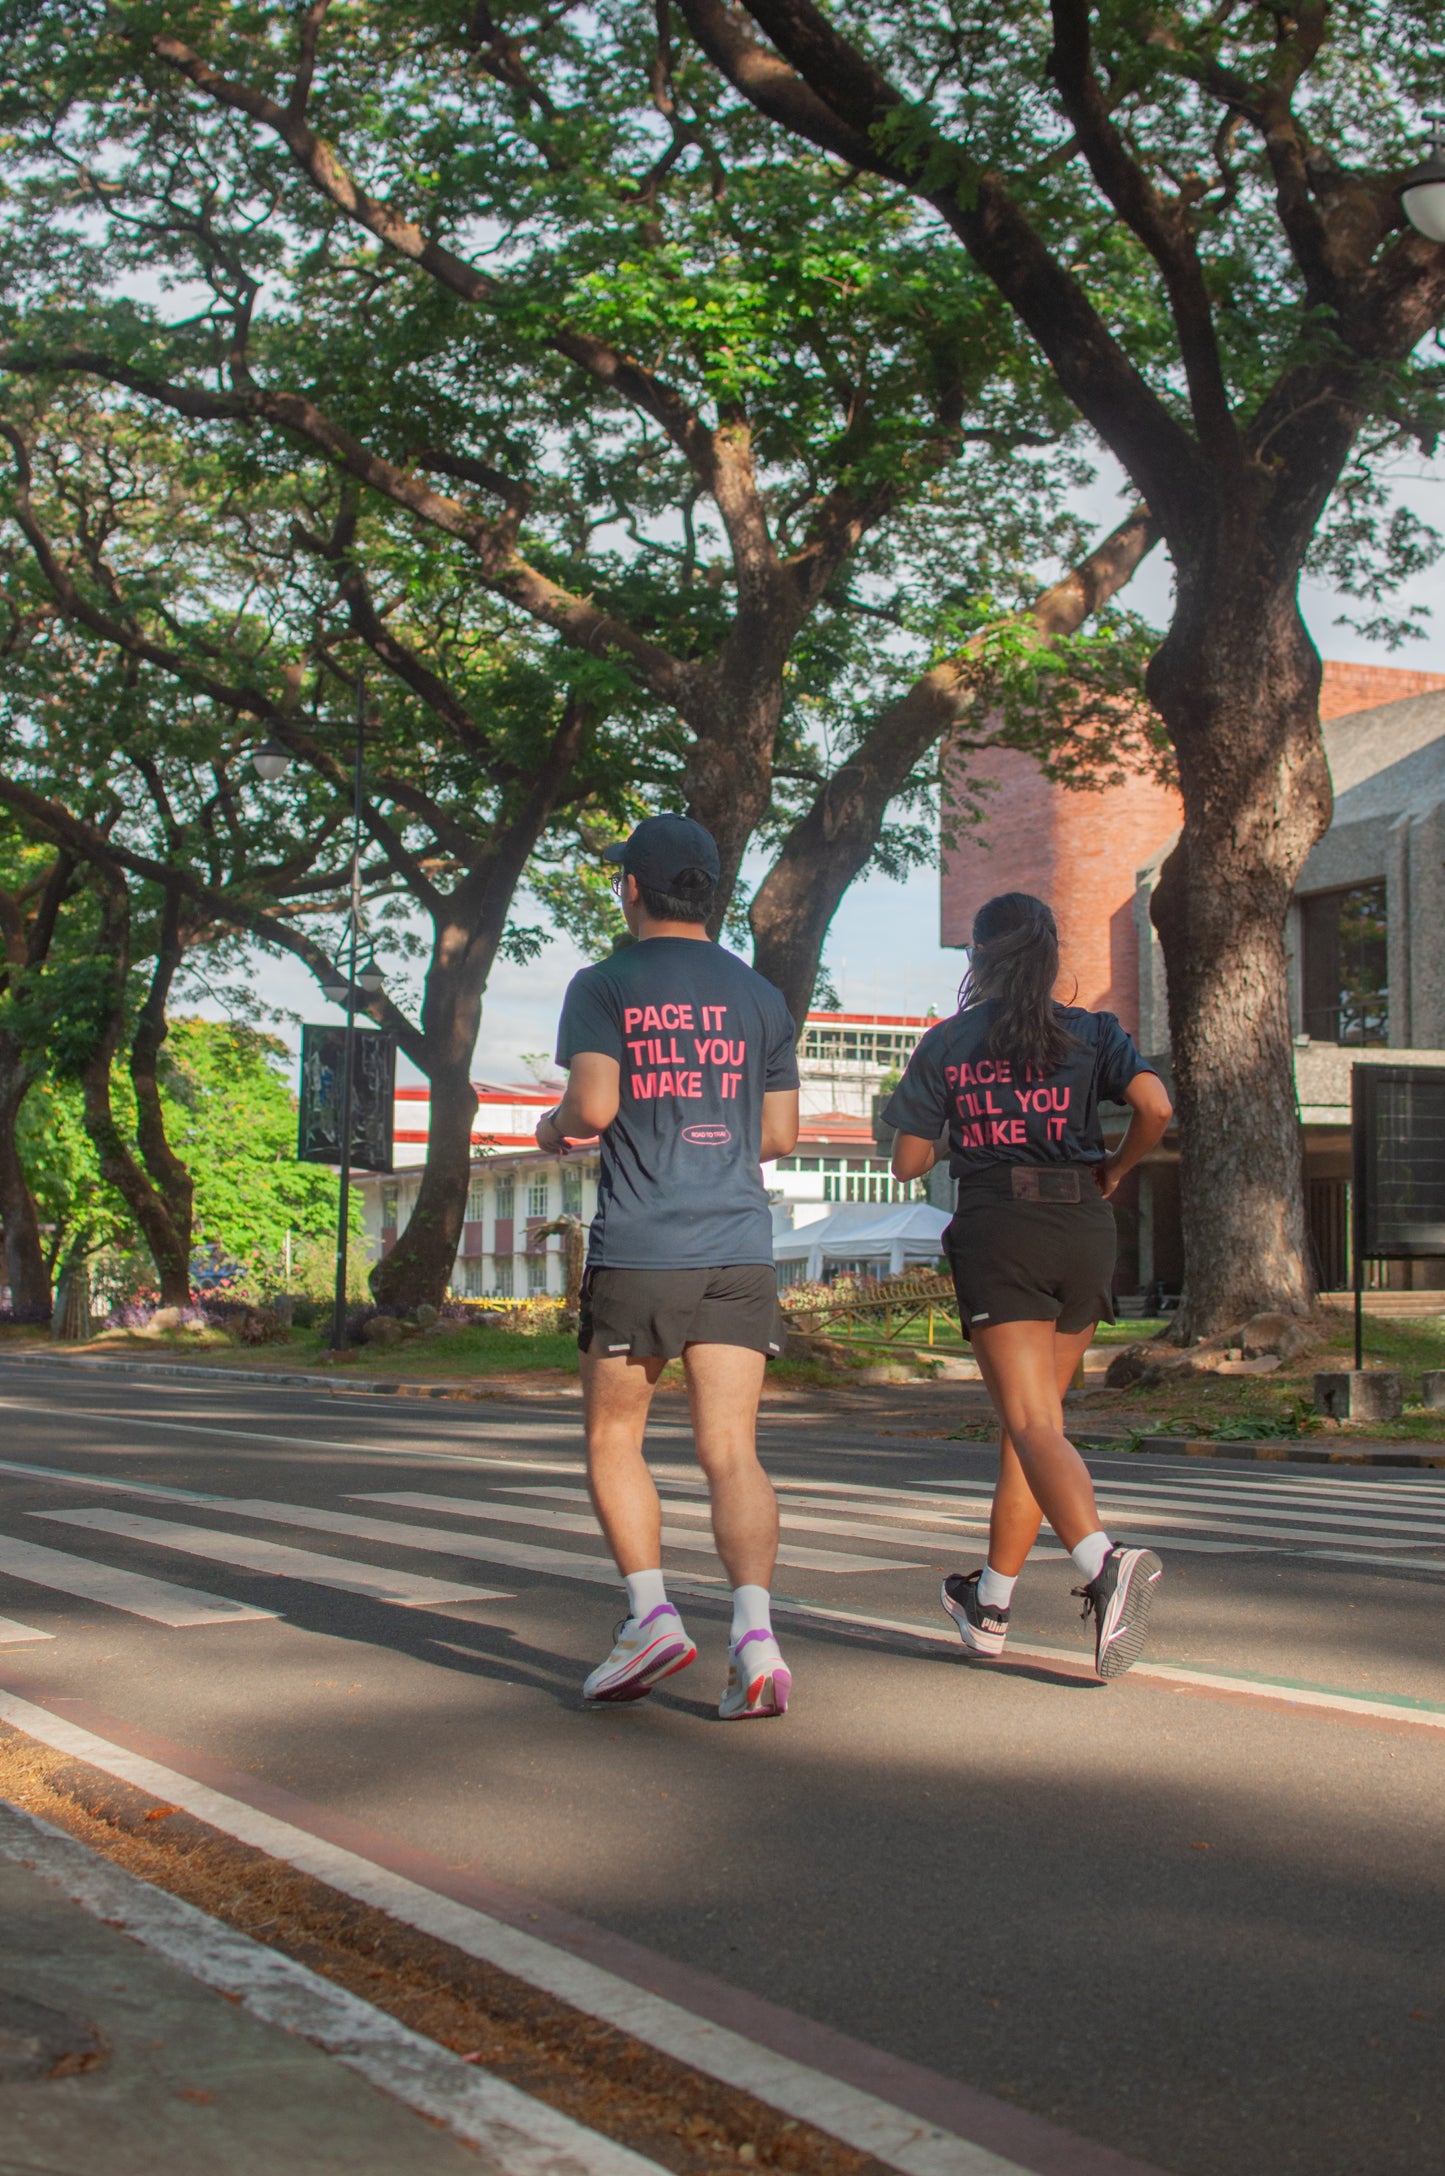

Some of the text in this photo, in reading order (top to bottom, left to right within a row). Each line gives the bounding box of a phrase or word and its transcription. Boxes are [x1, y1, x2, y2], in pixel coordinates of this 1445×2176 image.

[624, 1003, 727, 1034] PACE IT
[627, 1037, 745, 1066] TILL YOU
[631, 1071, 742, 1099] MAKE IT
[944, 1059, 1013, 1090] PACE
[1014, 1087, 1070, 1113] YOU
[1047, 1117, 1067, 1141] IT
